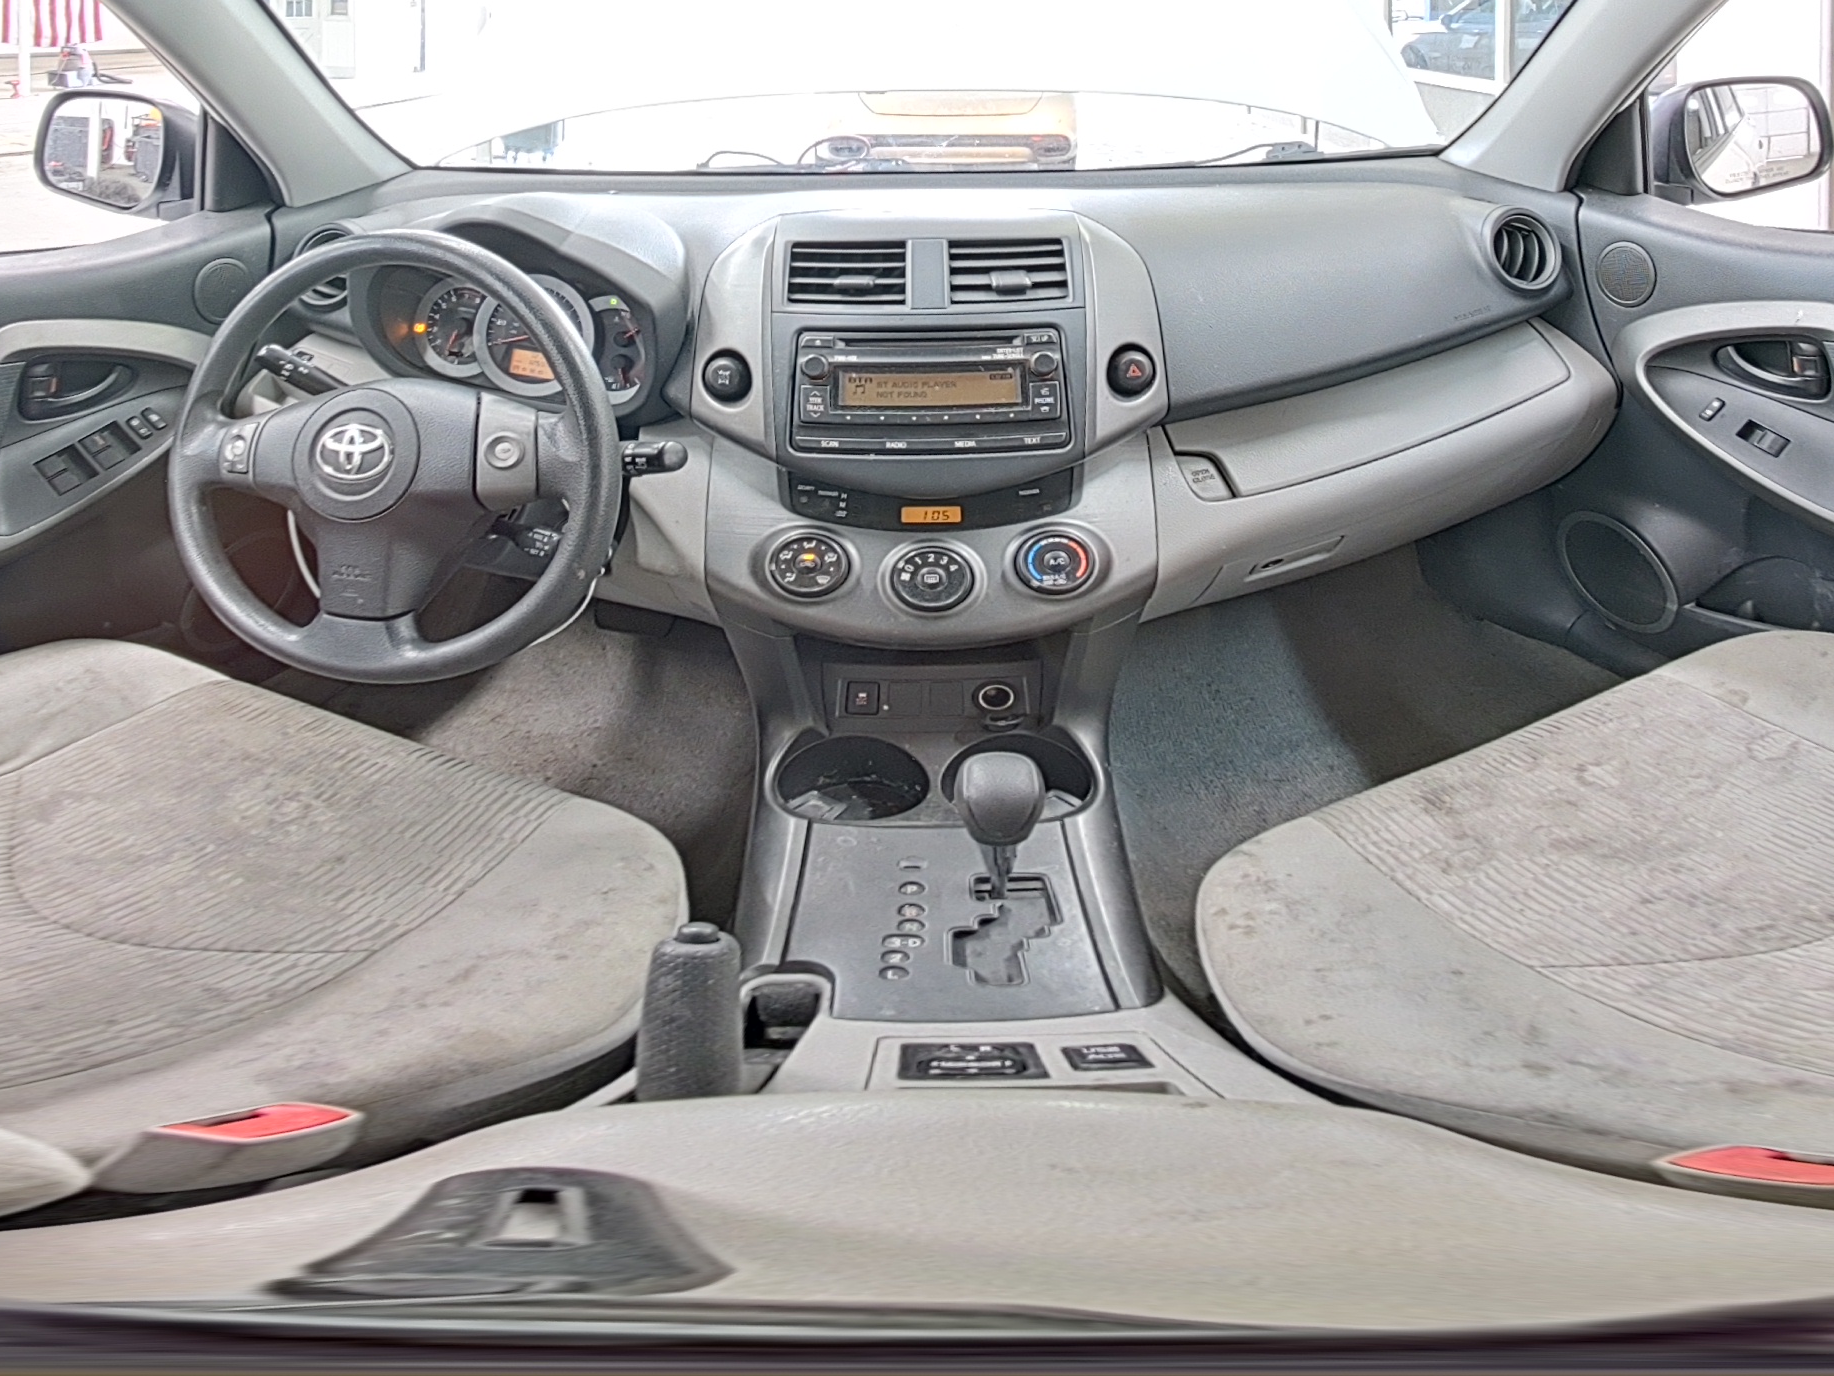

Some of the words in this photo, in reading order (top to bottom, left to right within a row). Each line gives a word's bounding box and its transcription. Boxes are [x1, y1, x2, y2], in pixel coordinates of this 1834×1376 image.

[891, 381, 919, 389] AUDIO
[922, 379, 957, 389] PLAYER
[876, 391, 894, 399] NOT
[897, 391, 927, 399] FOUND
[807, 404, 825, 412] TRACK
[821, 440, 839, 449] SCAN
[885, 440, 907, 449] RADIO
[954, 440, 976, 449] MEDIA
[1023, 437, 1041, 445] TEXT
[914, 555, 923, 565] 1
[927, 553, 935, 562] 2
[940, 555, 949, 565] 3
[1049, 557, 1066, 566] A/C
[905, 564, 915, 573] 0
[949, 564, 959, 572] 4
[907, 885, 917, 894] P
[889, 953, 903, 963] 2
[887, 970, 899, 980] L
